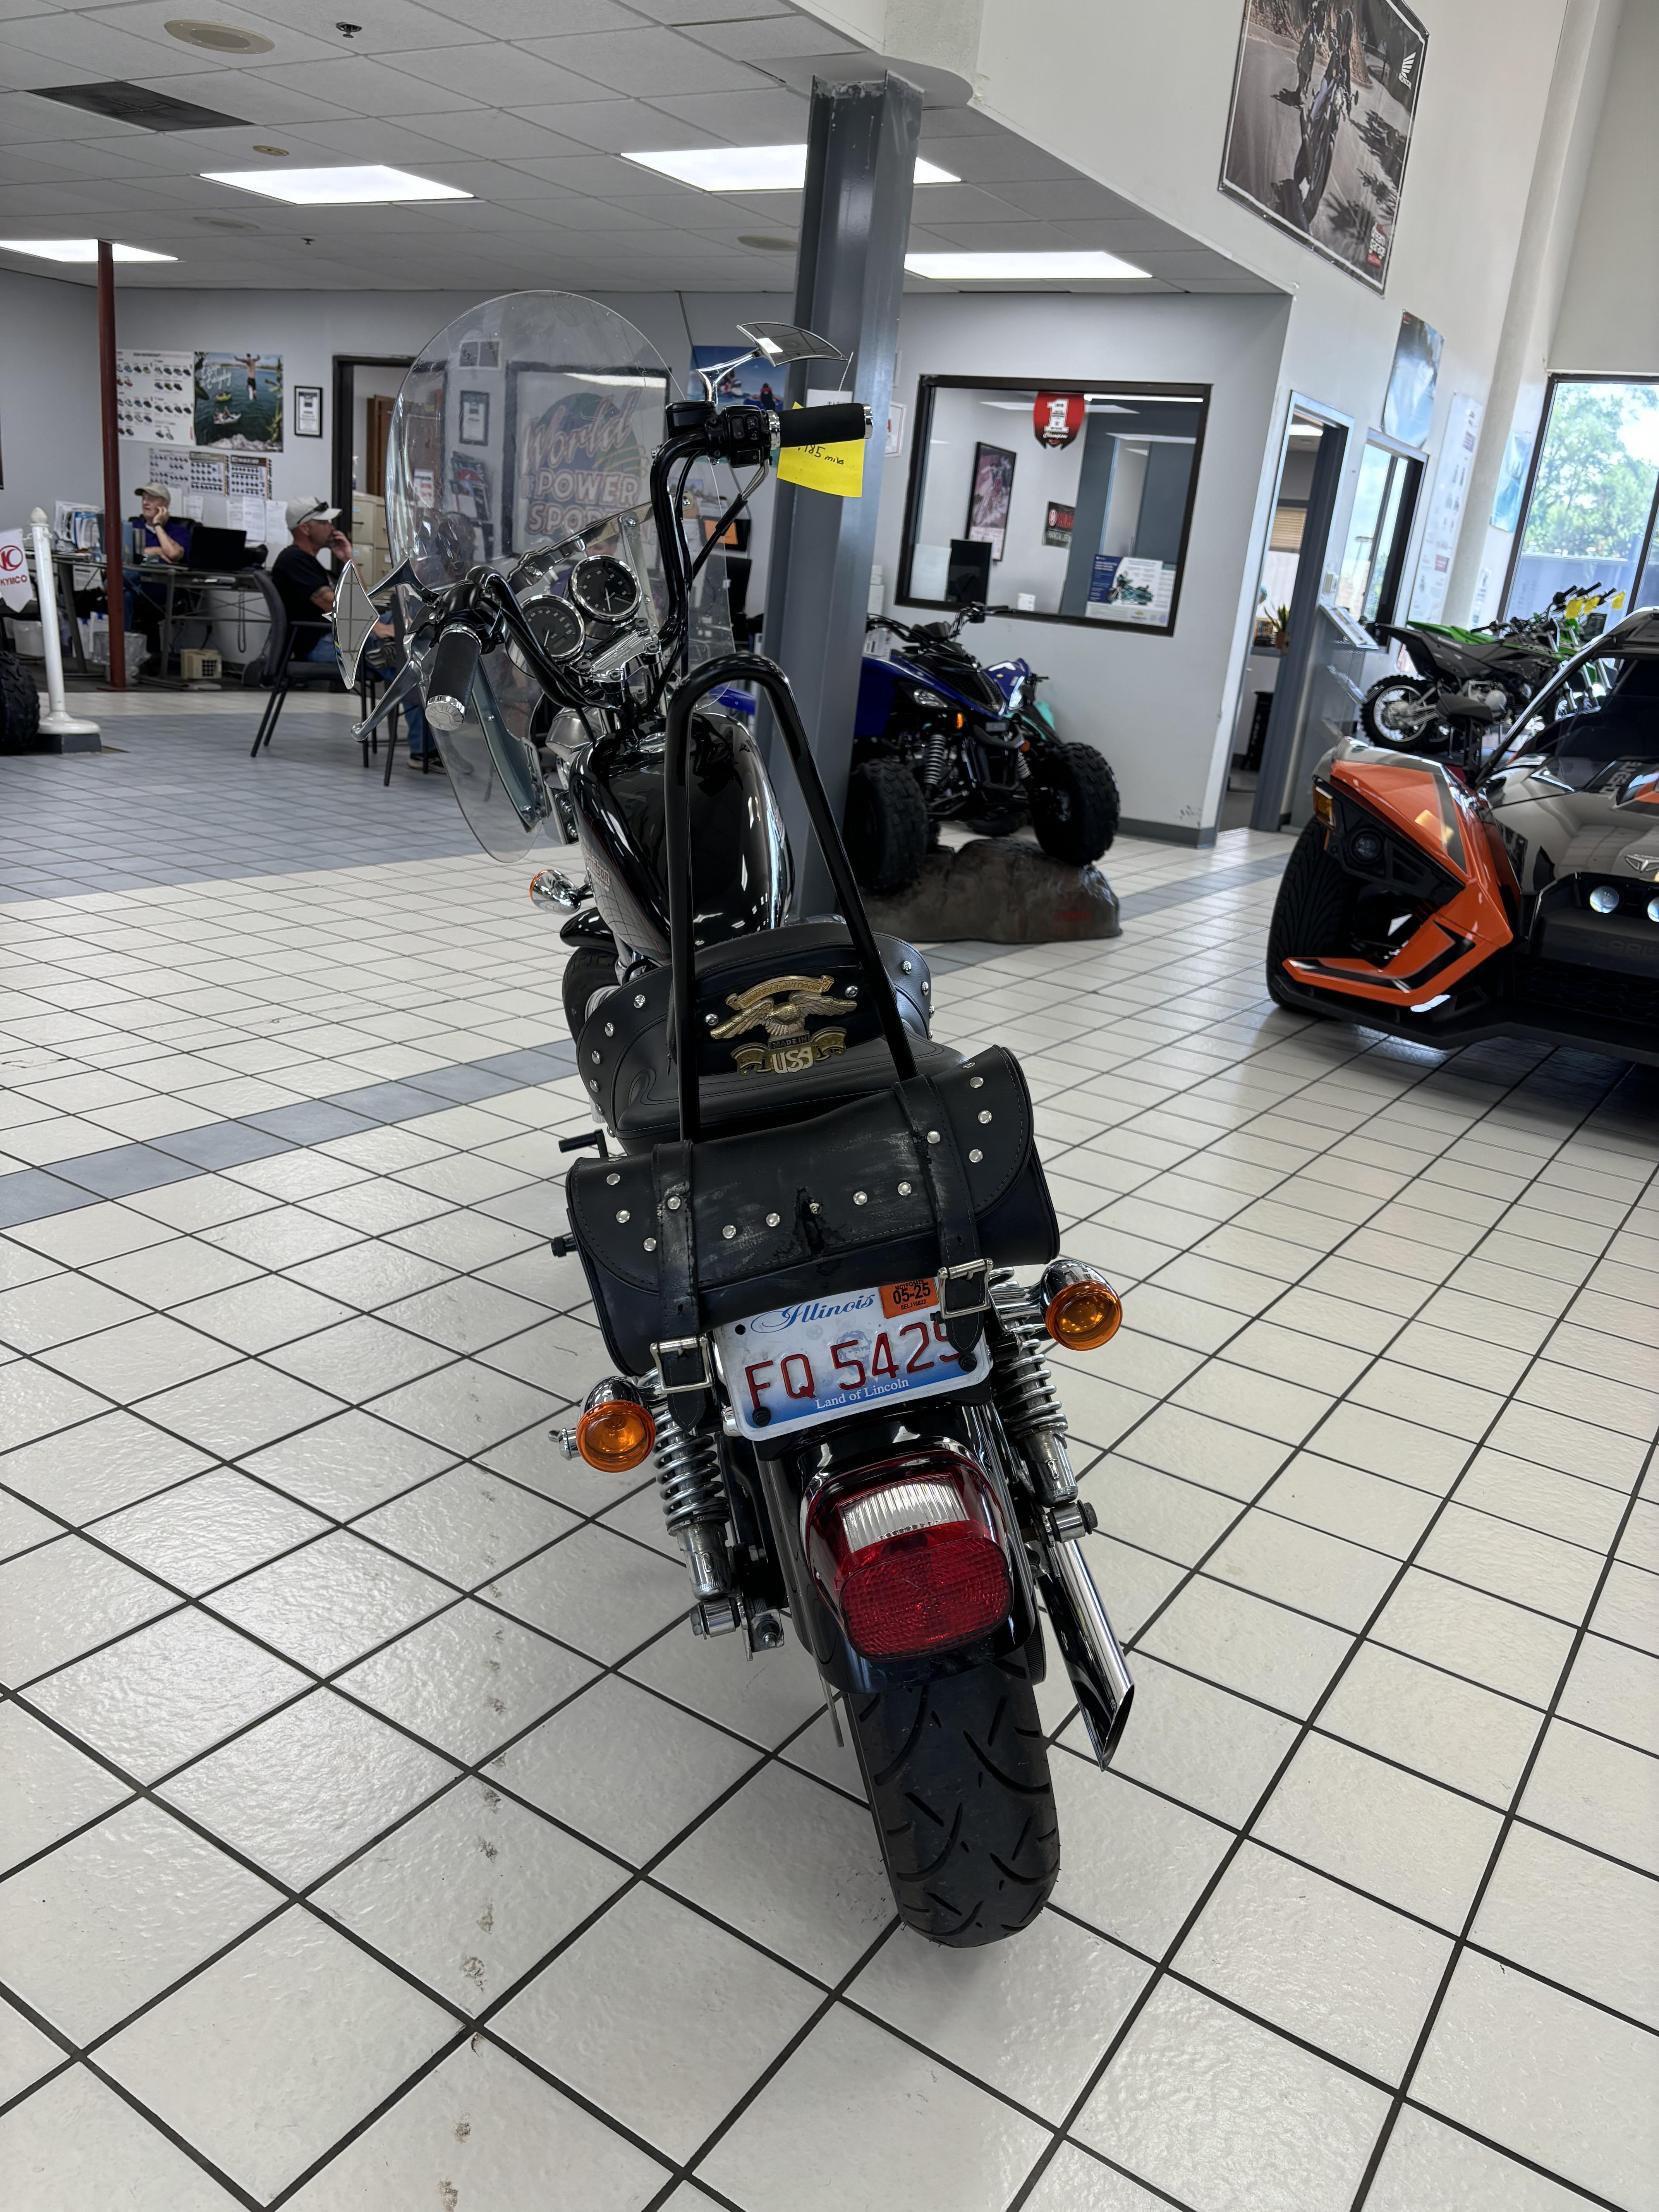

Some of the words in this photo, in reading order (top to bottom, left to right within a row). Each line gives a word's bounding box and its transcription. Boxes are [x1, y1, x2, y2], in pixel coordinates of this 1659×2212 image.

[520, 387, 642, 473] World
[534, 468, 640, 507] POWER
[0, 575, 27, 586] KYMCO
[772, 1038, 797, 1048] MADE
[772, 1047, 813, 1074] USA
[893, 1283, 931, 1304] 05-25
[750, 1294, 875, 1333] Illinois
[745, 1353, 816, 1409] FQ
[815, 1393, 847, 1409] Land
[849, 1389, 861, 1401] of
[864, 1379, 910, 1397] Lincoln
